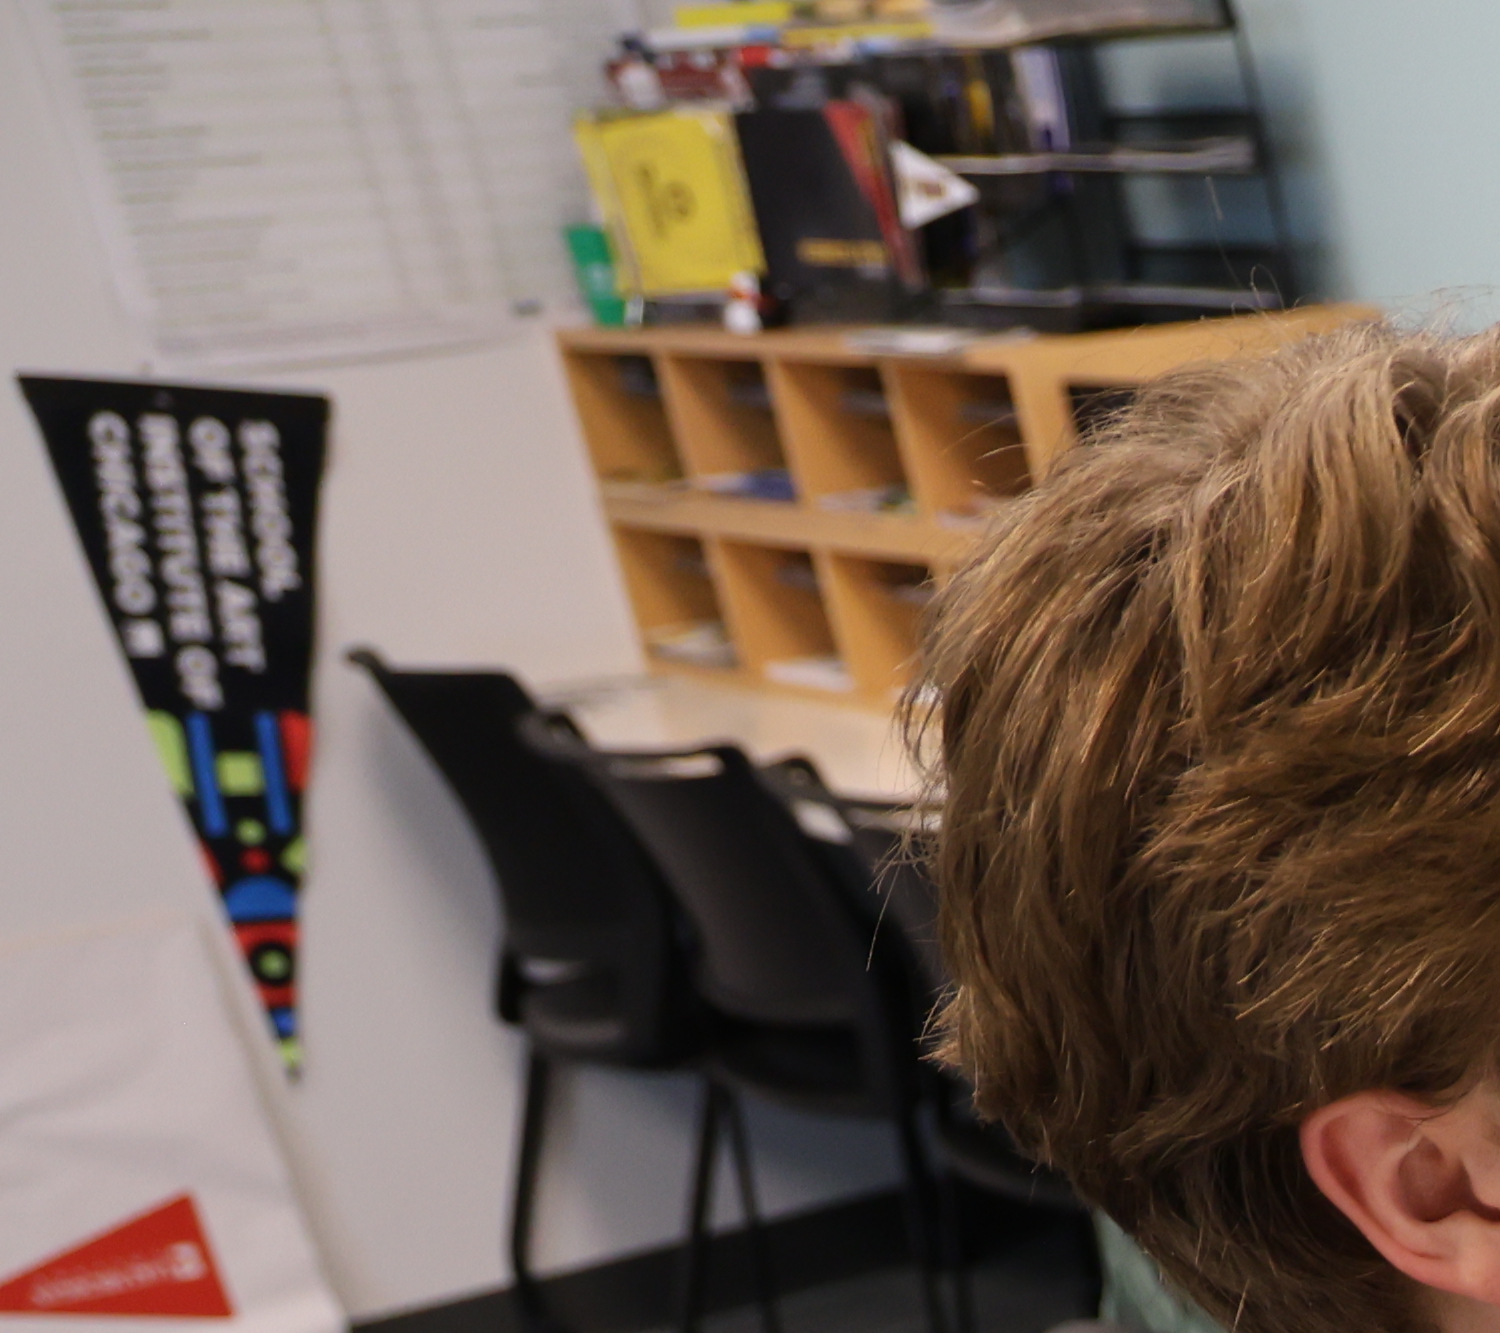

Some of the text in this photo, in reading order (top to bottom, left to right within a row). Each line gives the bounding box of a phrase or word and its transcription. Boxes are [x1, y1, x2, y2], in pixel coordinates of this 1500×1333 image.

[87, 410, 158, 616] CHICAGO
[137, 412, 225, 712] INSTITUTE OF
[188, 414, 267, 674] OF THE ART
[237, 417, 302, 602] SCHOOL
